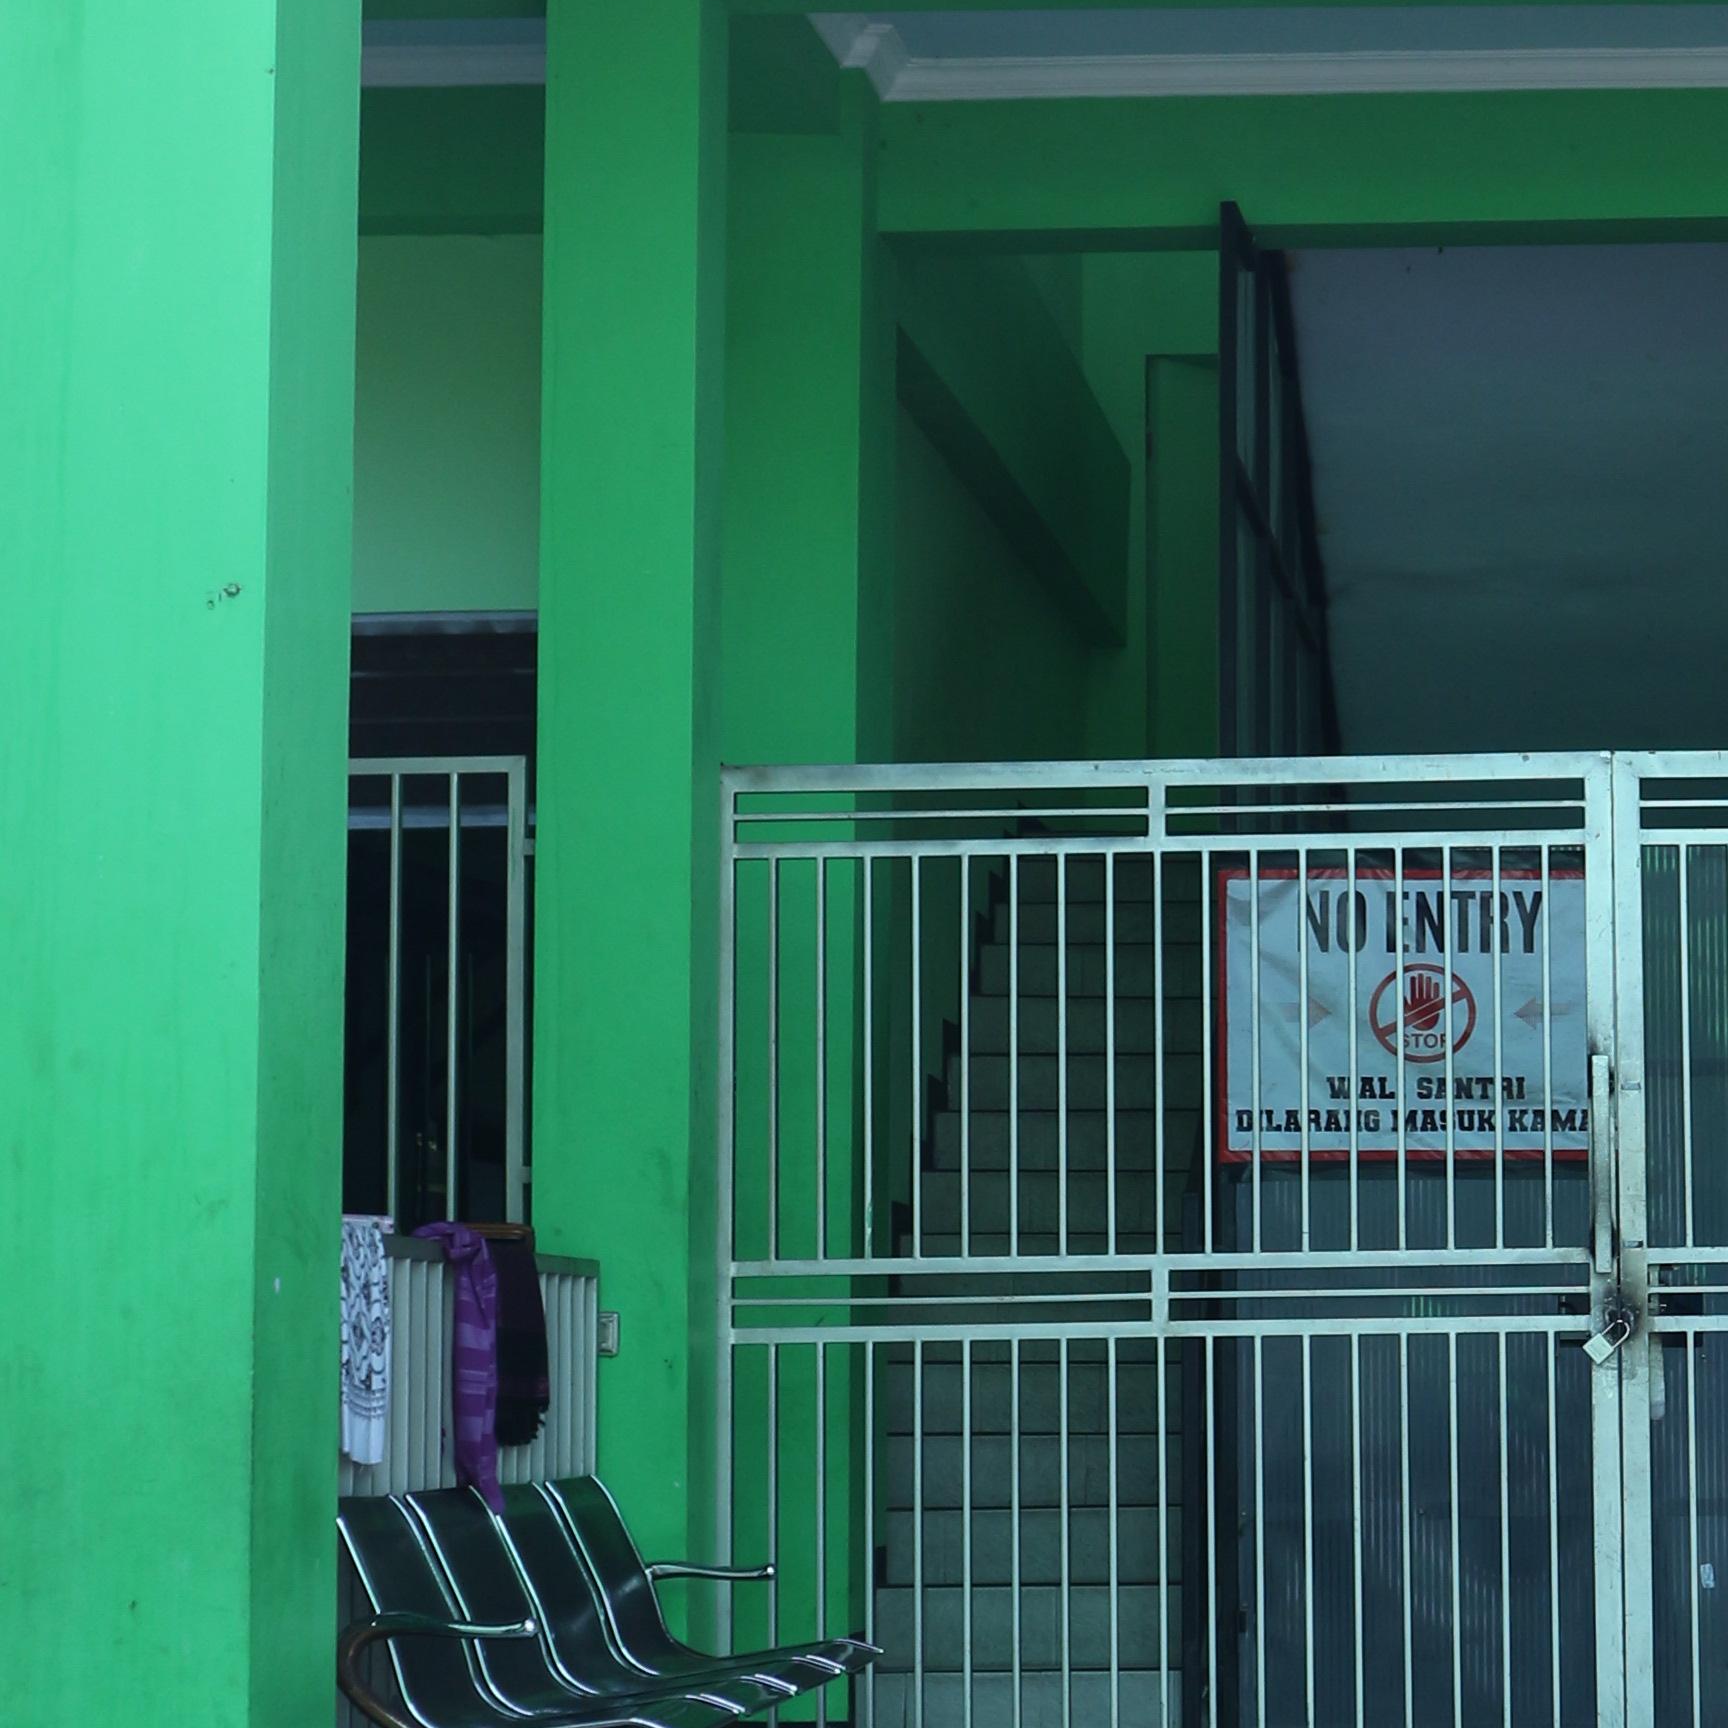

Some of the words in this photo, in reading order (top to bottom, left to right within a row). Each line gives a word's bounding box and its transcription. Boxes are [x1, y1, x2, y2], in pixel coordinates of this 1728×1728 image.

[1297, 890, 1367, 953] NO
[1386, 890, 1543, 954] ENTRY
[1326, 1076, 1404, 1100] WAL
[1507, 1108, 1589, 1132] KAMA
